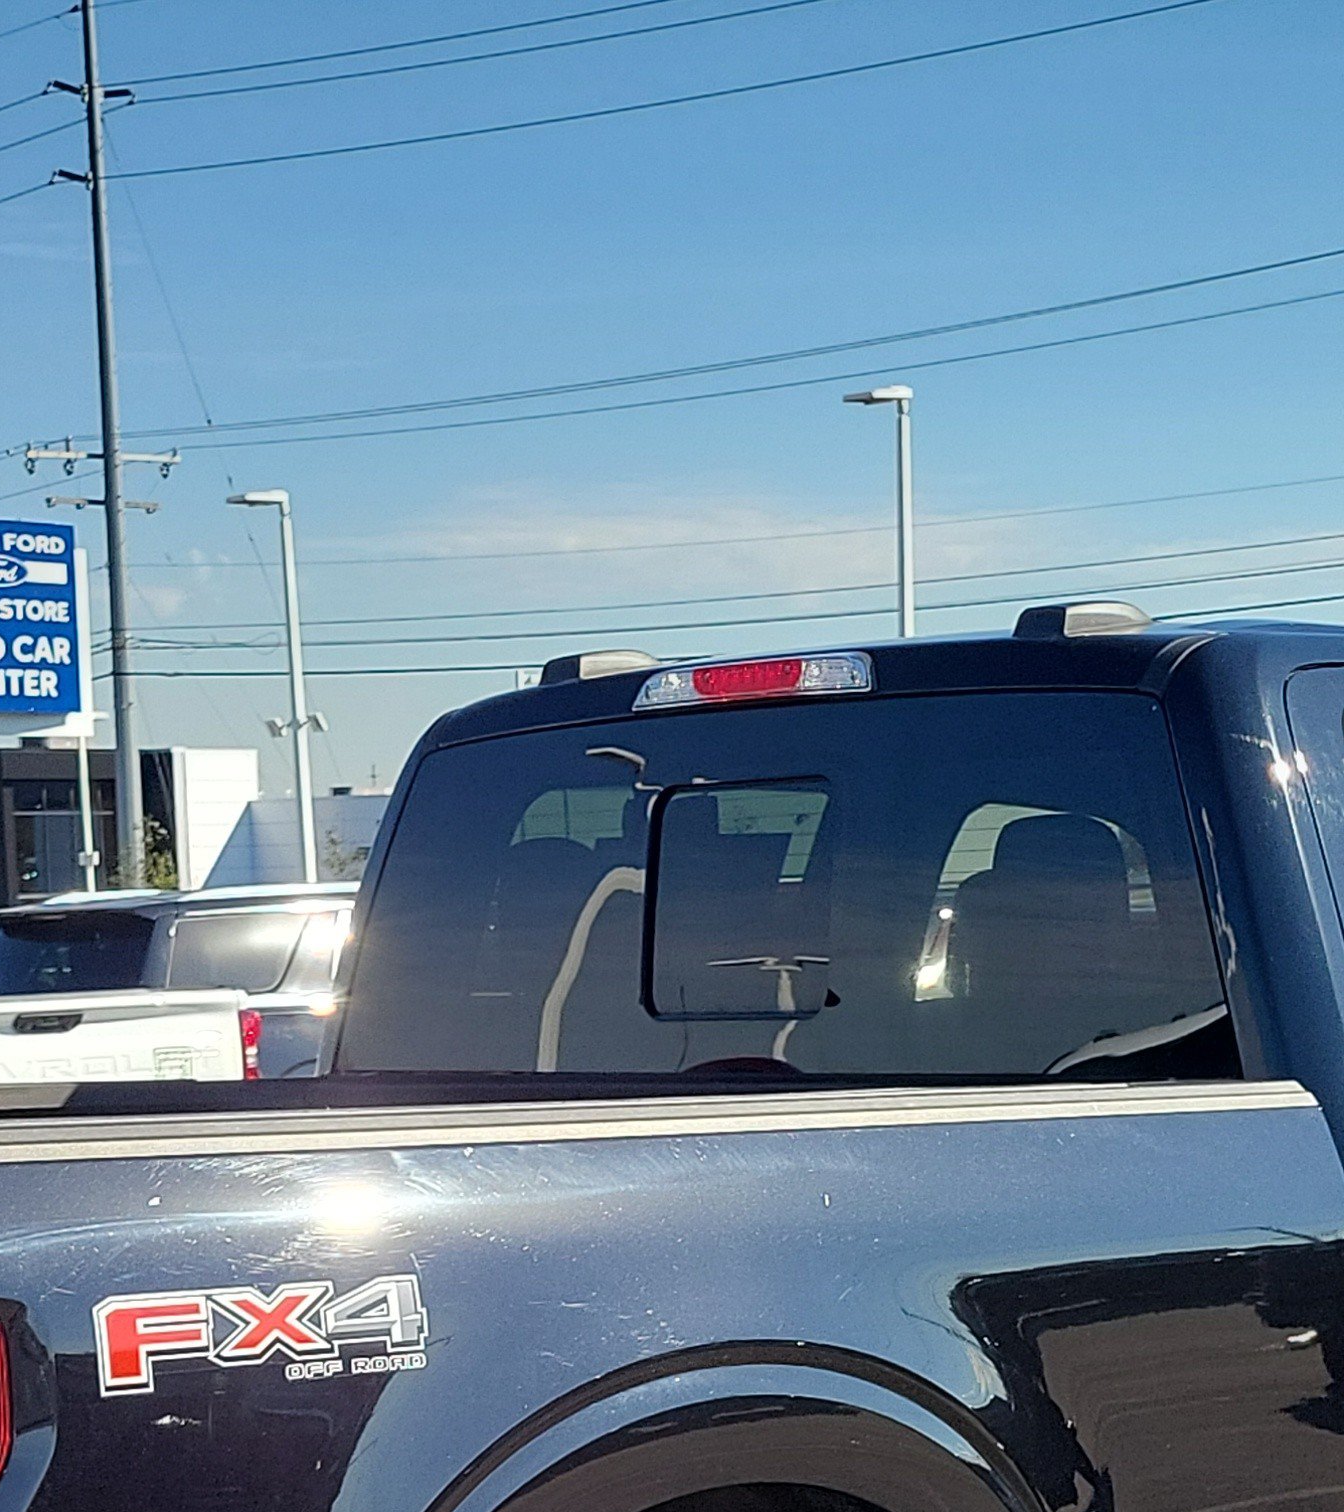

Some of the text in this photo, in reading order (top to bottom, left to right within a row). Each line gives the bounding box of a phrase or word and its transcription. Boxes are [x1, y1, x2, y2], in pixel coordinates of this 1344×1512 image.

[3, 532, 66, 555] FORD
[12, 635, 71, 665] CAR
[93, 1275, 430, 1397] FX4
[285, 1353, 428, 1382] OFF ROAD
